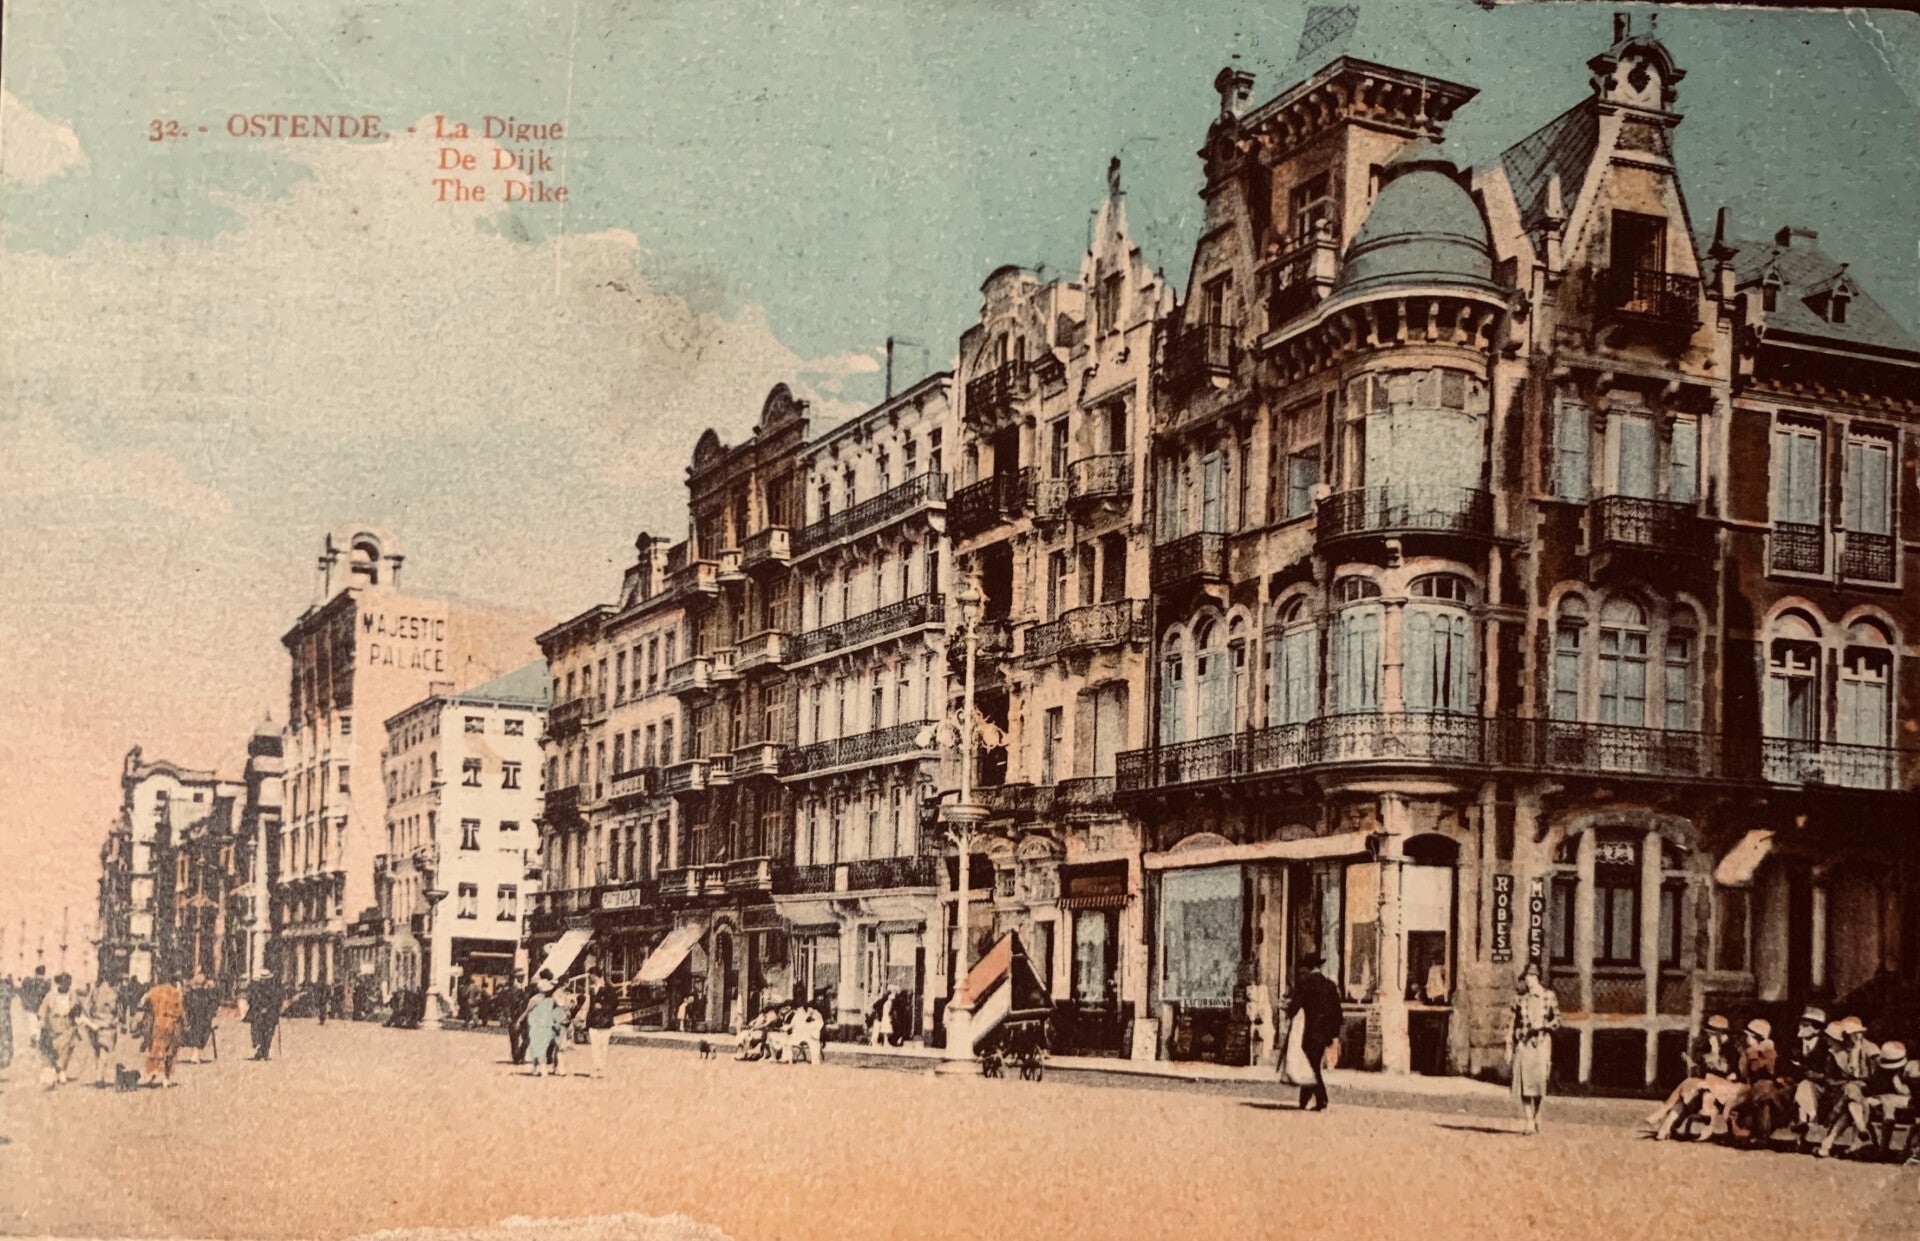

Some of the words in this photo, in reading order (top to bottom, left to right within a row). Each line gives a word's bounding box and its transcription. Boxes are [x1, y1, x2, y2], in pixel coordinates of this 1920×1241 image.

[370, 643, 444, 672] PALACE
[1495, 876, 1508, 948] ROBES
[1531, 881, 1543, 956] MODES
